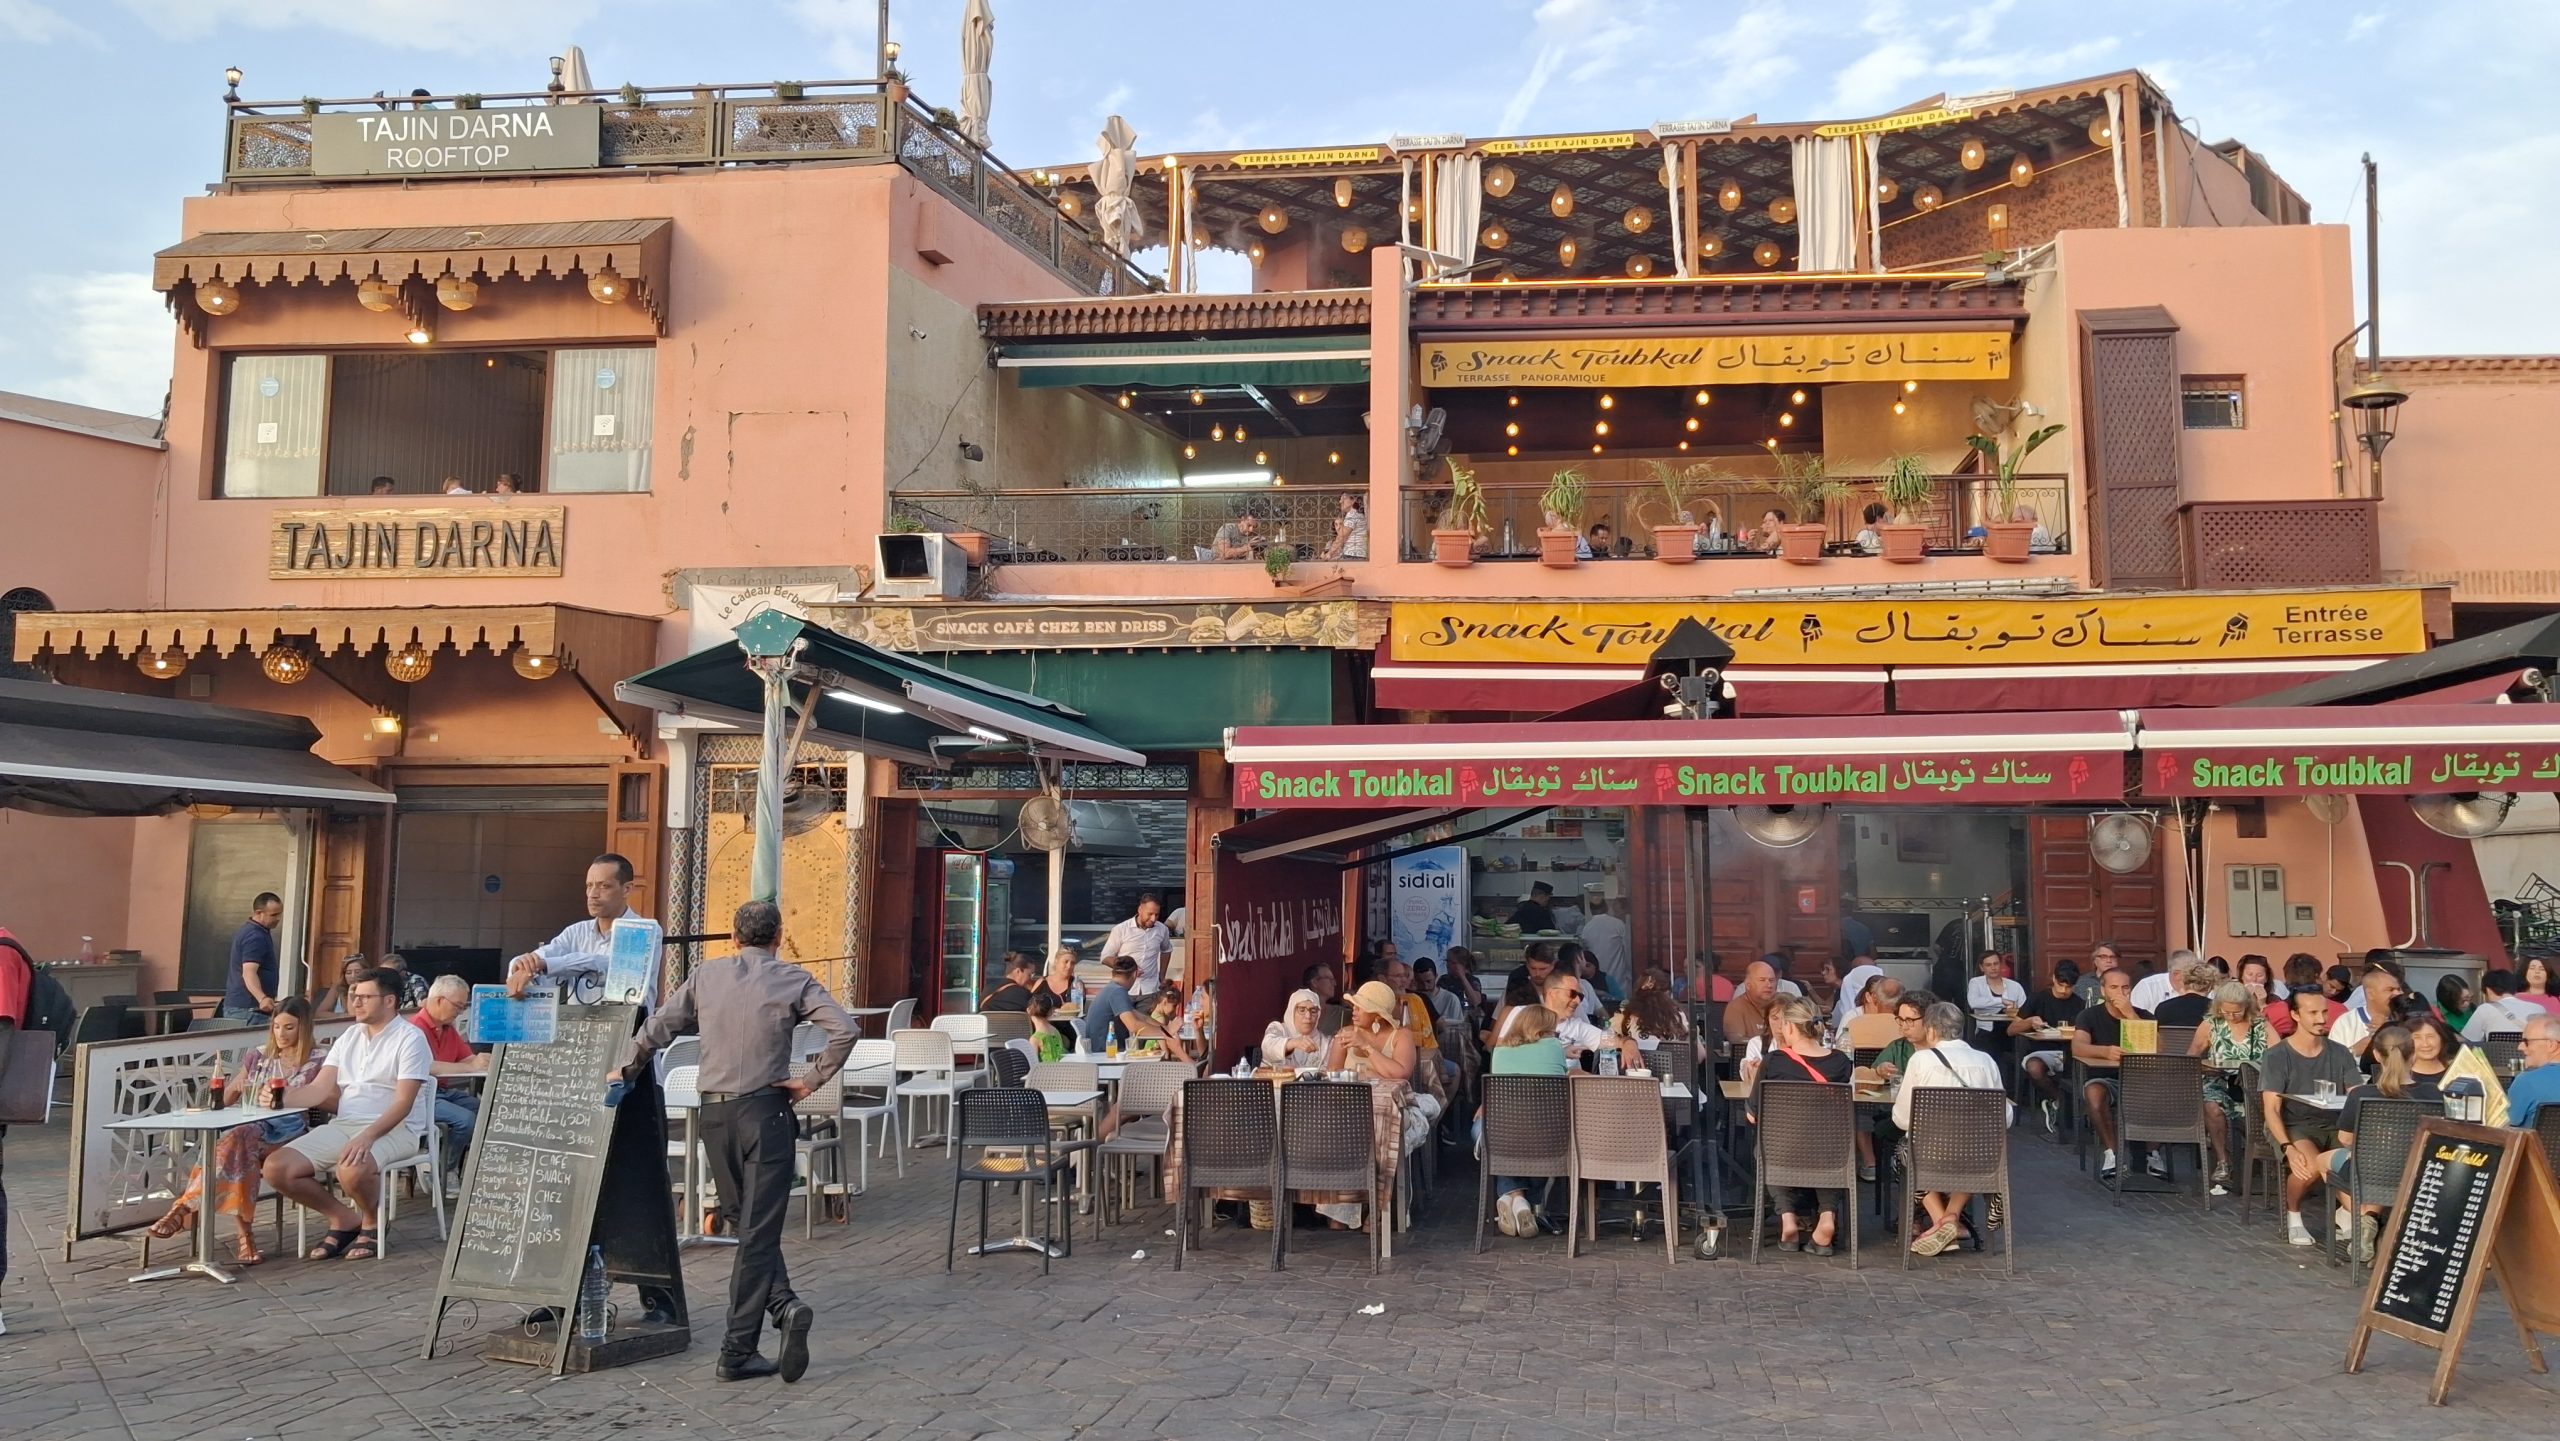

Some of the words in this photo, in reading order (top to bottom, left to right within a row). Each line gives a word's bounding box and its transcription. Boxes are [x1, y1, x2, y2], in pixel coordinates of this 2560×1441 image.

[356, 115, 438, 142] TAJIN
[450, 112, 554, 140] DARNA
[1706, 120, 1729, 131] DARNA
[1889, 115, 1923, 127] TAJIN
[1442, 135, 1463, 145] DARNA
[1554, 137, 1587, 147] TAJIN
[1592, 135, 1632, 145] DARNA
[387, 145, 509, 168] ROOFTOP
[1243, 153, 1297, 163] TERRASSE
[1301, 152, 1333, 161] TAJIN
[1339, 150, 1376, 159] DARNA
[1456, 349, 1565, 371] Snack
[1572, 347, 1703, 371] Toubkal
[1457, 373, 1511, 383] TERRASSE
[1521, 373, 1606, 383] PANORAMIQUE
[281, 521, 398, 569] TAJIN
[414, 520, 559, 568] DARNA
[718, 606, 733, 620] Le
[731, 586, 770, 607] Cadeau
[2286, 603, 2369, 622] Entrée
[936, 622, 989, 635] SNACK
[993, 618, 1035, 634] CAFÉ
[1039, 621, 1080, 634] CHEZ
[1084, 621, 1117, 633] BEN
[1121, 620, 1167, 633] DRISS
[1419, 615, 1576, 647] Snack
[1582, 616, 1775, 653] Toukal
[2273, 624, 2384, 644] Terrasse
[1571, 766, 1638, 791] سناك
[1677, 766, 1765, 796] Snack
[1774, 764, 1886, 793] Toubkal
[1893, 758, 1976, 792] توبقال
[1982, 758, 2051, 785] سناك
[2193, 757, 2283, 787] Snack
[2294, 755, 2412, 786] Toubkal
[2431, 751, 2520, 785] توبقال
[1259, 769, 1340, 798] Snack
[1348, 768, 1452, 798] Toubkal
[1482, 765, 1561, 798] توبقال
[1398, 872, 1430, 889] sidi
[1432, 873, 1455, 889] ali
[535, 1190, 562, 1203] CHEZ
